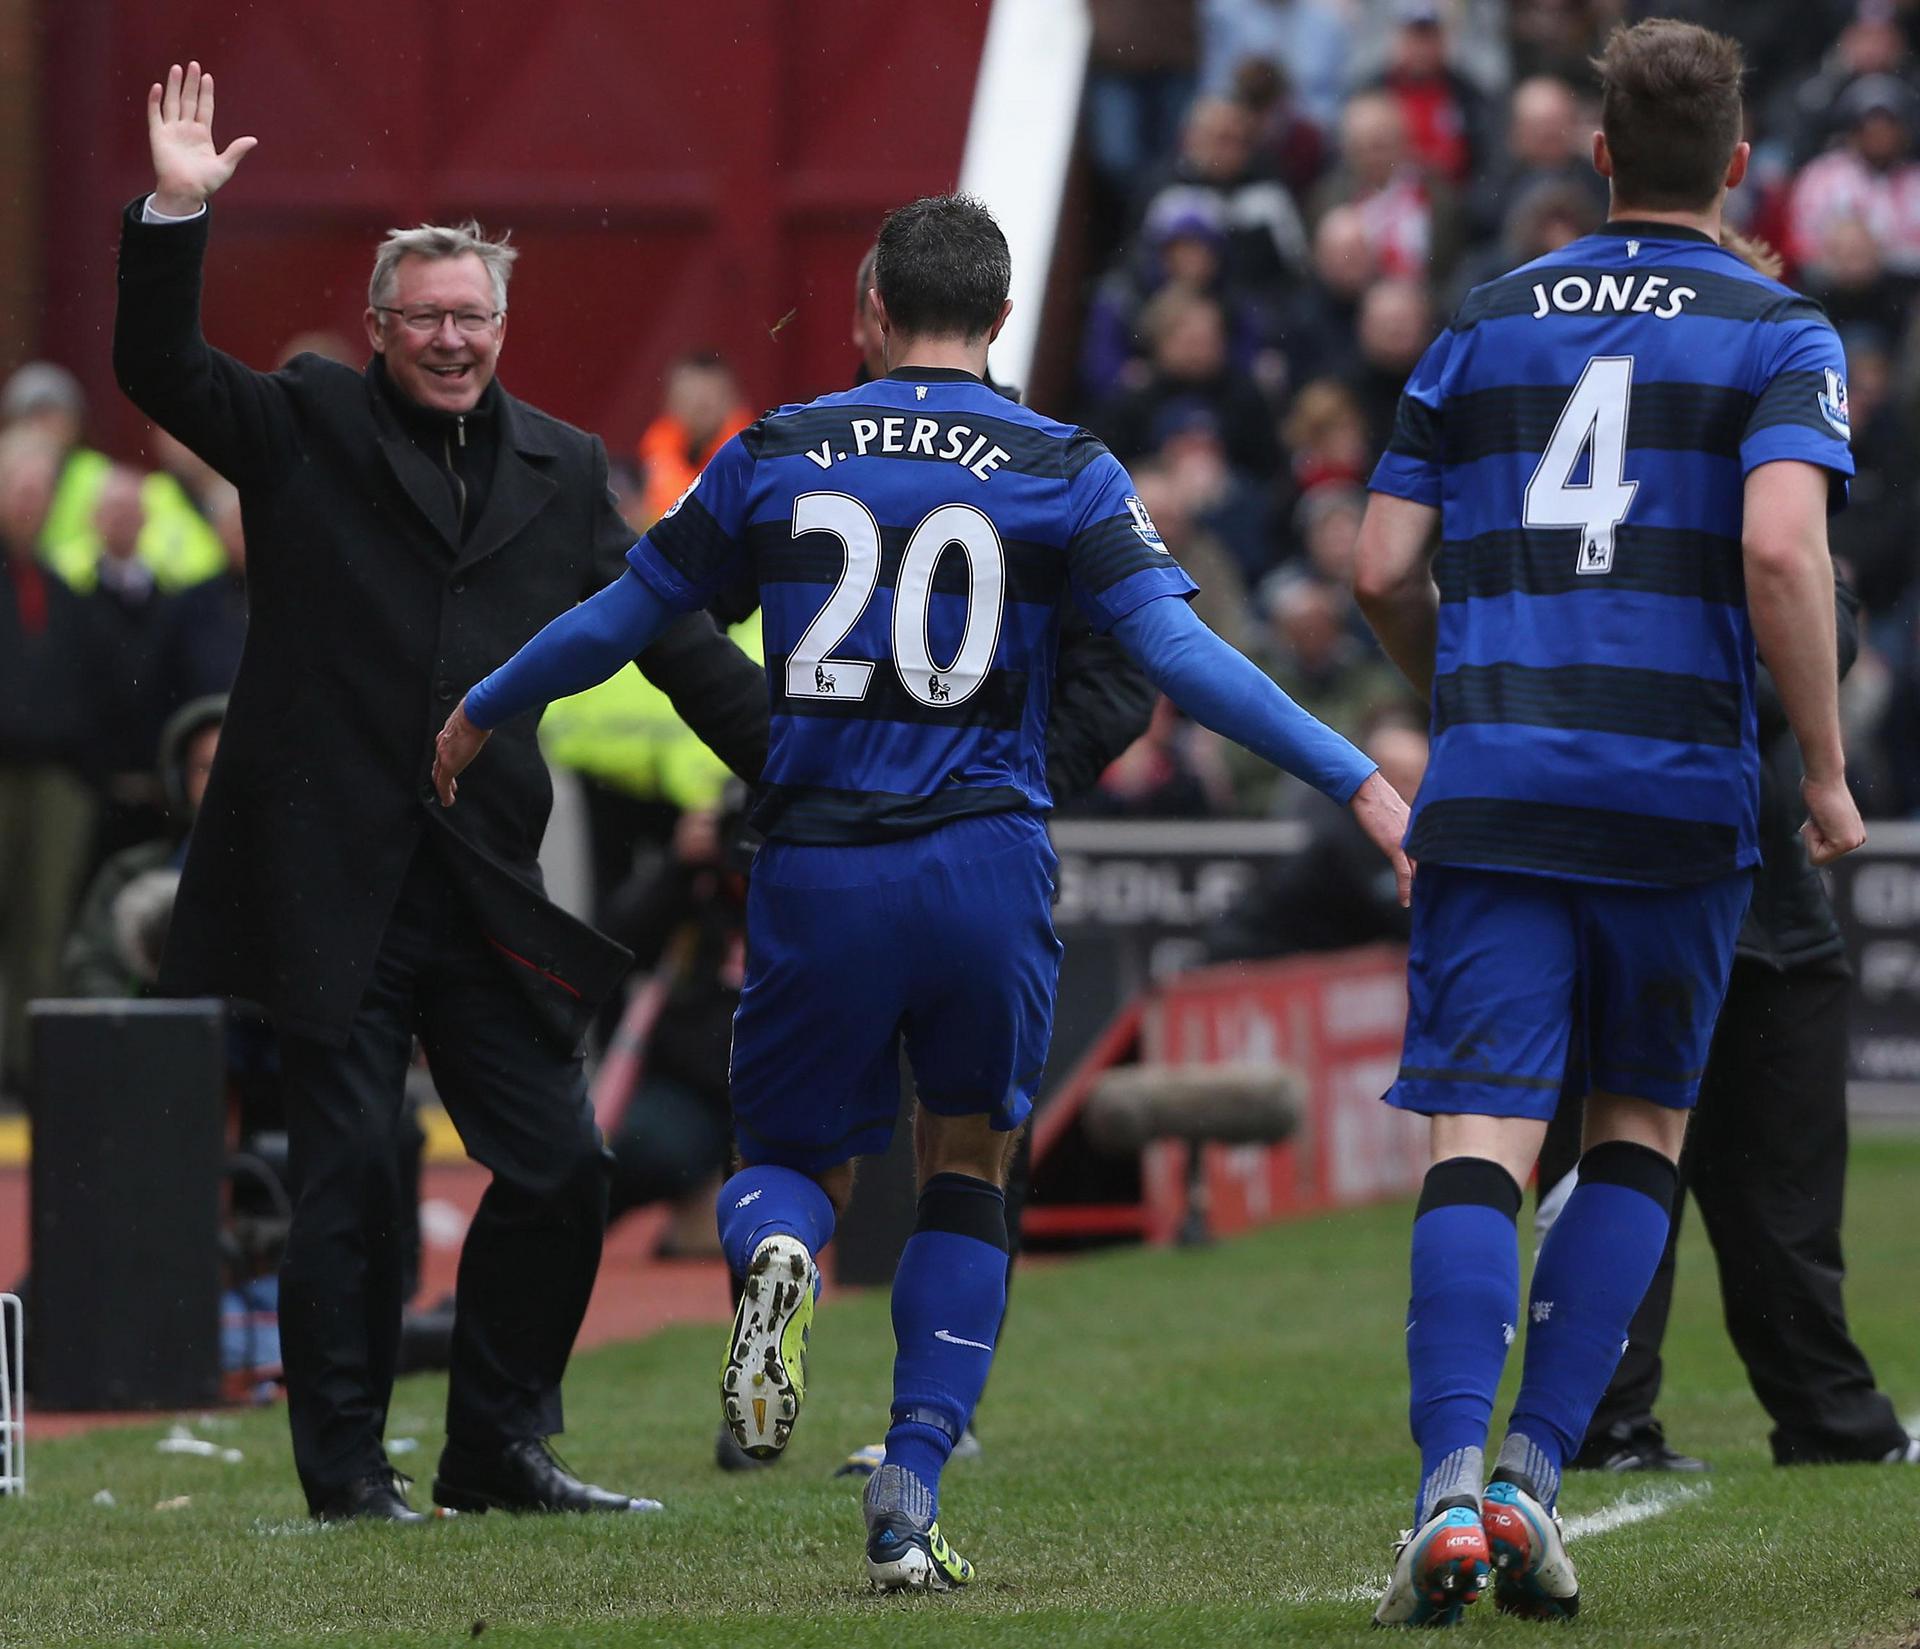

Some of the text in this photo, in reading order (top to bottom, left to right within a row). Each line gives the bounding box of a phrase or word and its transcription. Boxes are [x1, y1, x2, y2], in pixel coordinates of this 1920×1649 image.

[1532, 274, 1697, 320] JONES
[851, 417, 1012, 482] PERSIE
[1522, 355, 1640, 575] 4
[785, 490, 1006, 708] 20
